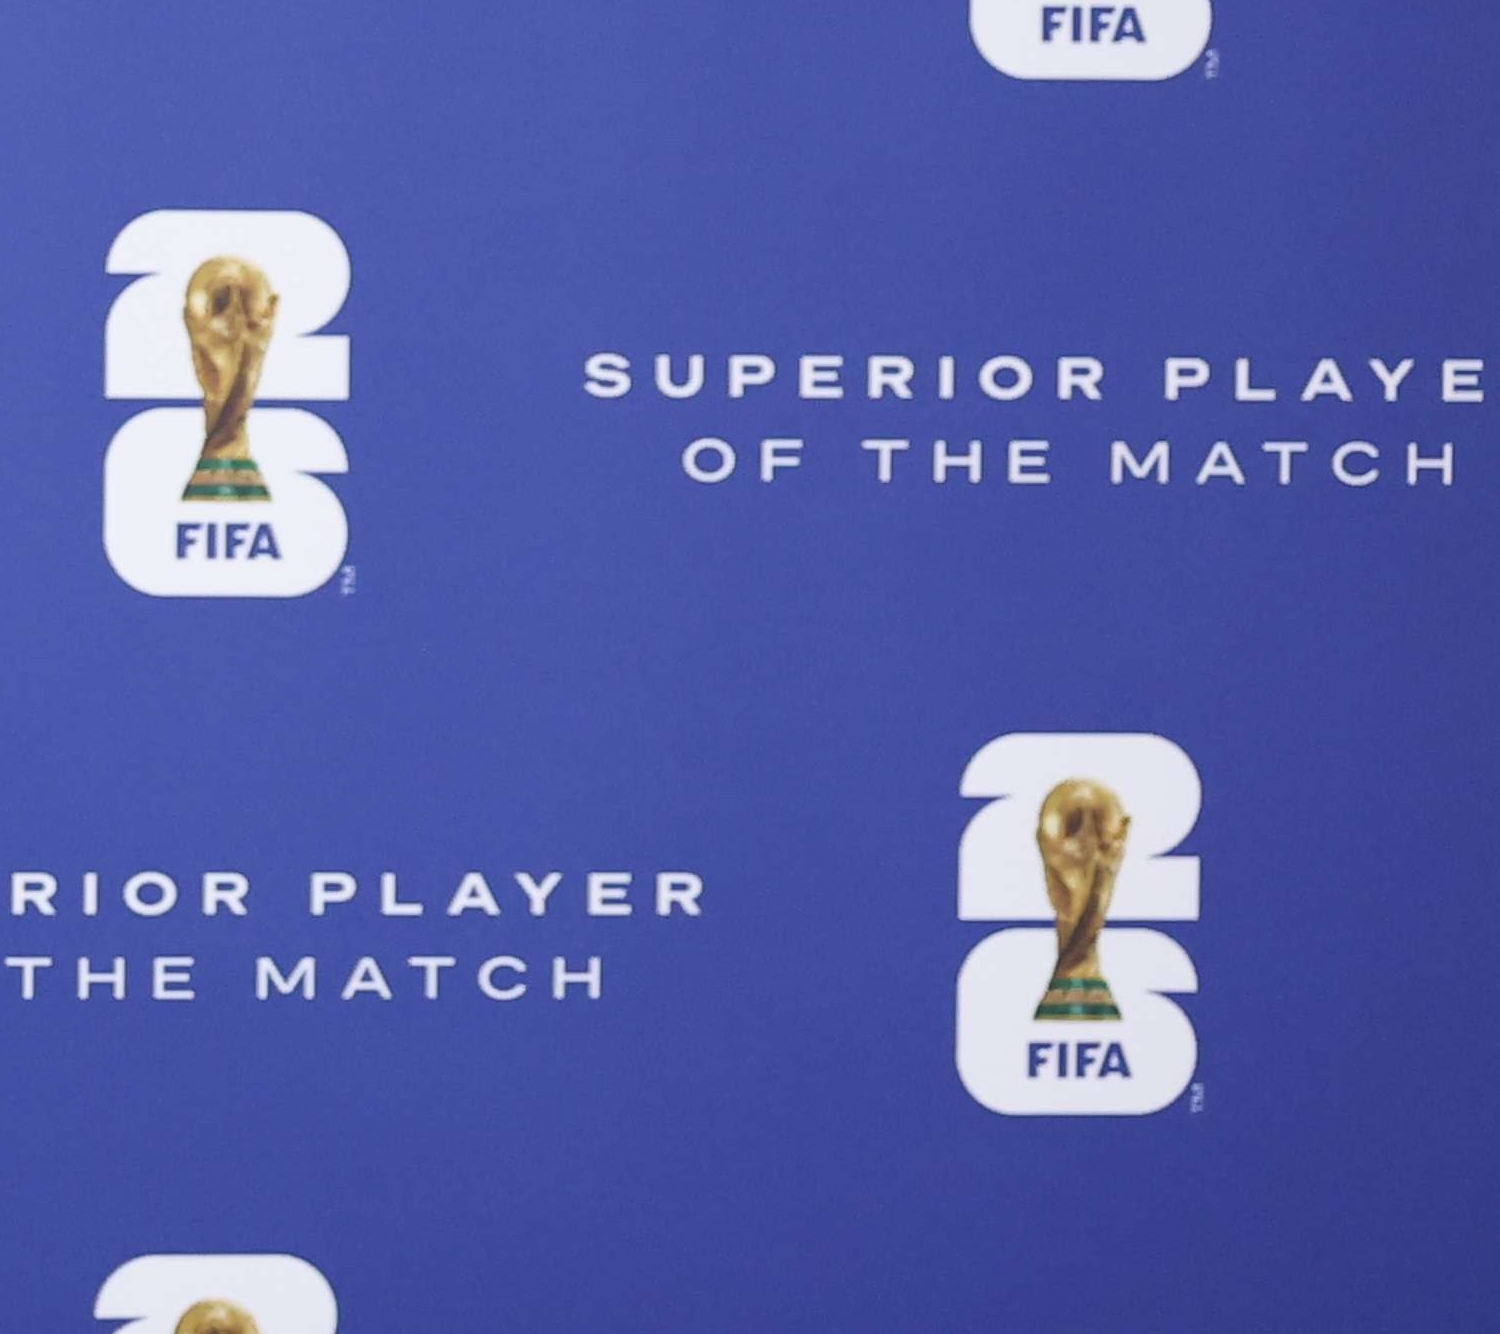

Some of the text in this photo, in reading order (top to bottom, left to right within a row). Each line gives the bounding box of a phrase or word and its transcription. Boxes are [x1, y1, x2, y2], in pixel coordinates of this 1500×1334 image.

[1041, 5, 1146, 44] FIFA
[583, 352, 1484, 403] SUPERIOR PLAYE
[682, 437, 1453, 486] OF THE MATCH
[175, 522, 282, 560] FIFA
[309, 872, 703, 916] PLAYER
[4, 956, 195, 1001] THE
[256, 955, 601, 1001] MATCH
[1027, 1041, 1132, 1079] FIFA
